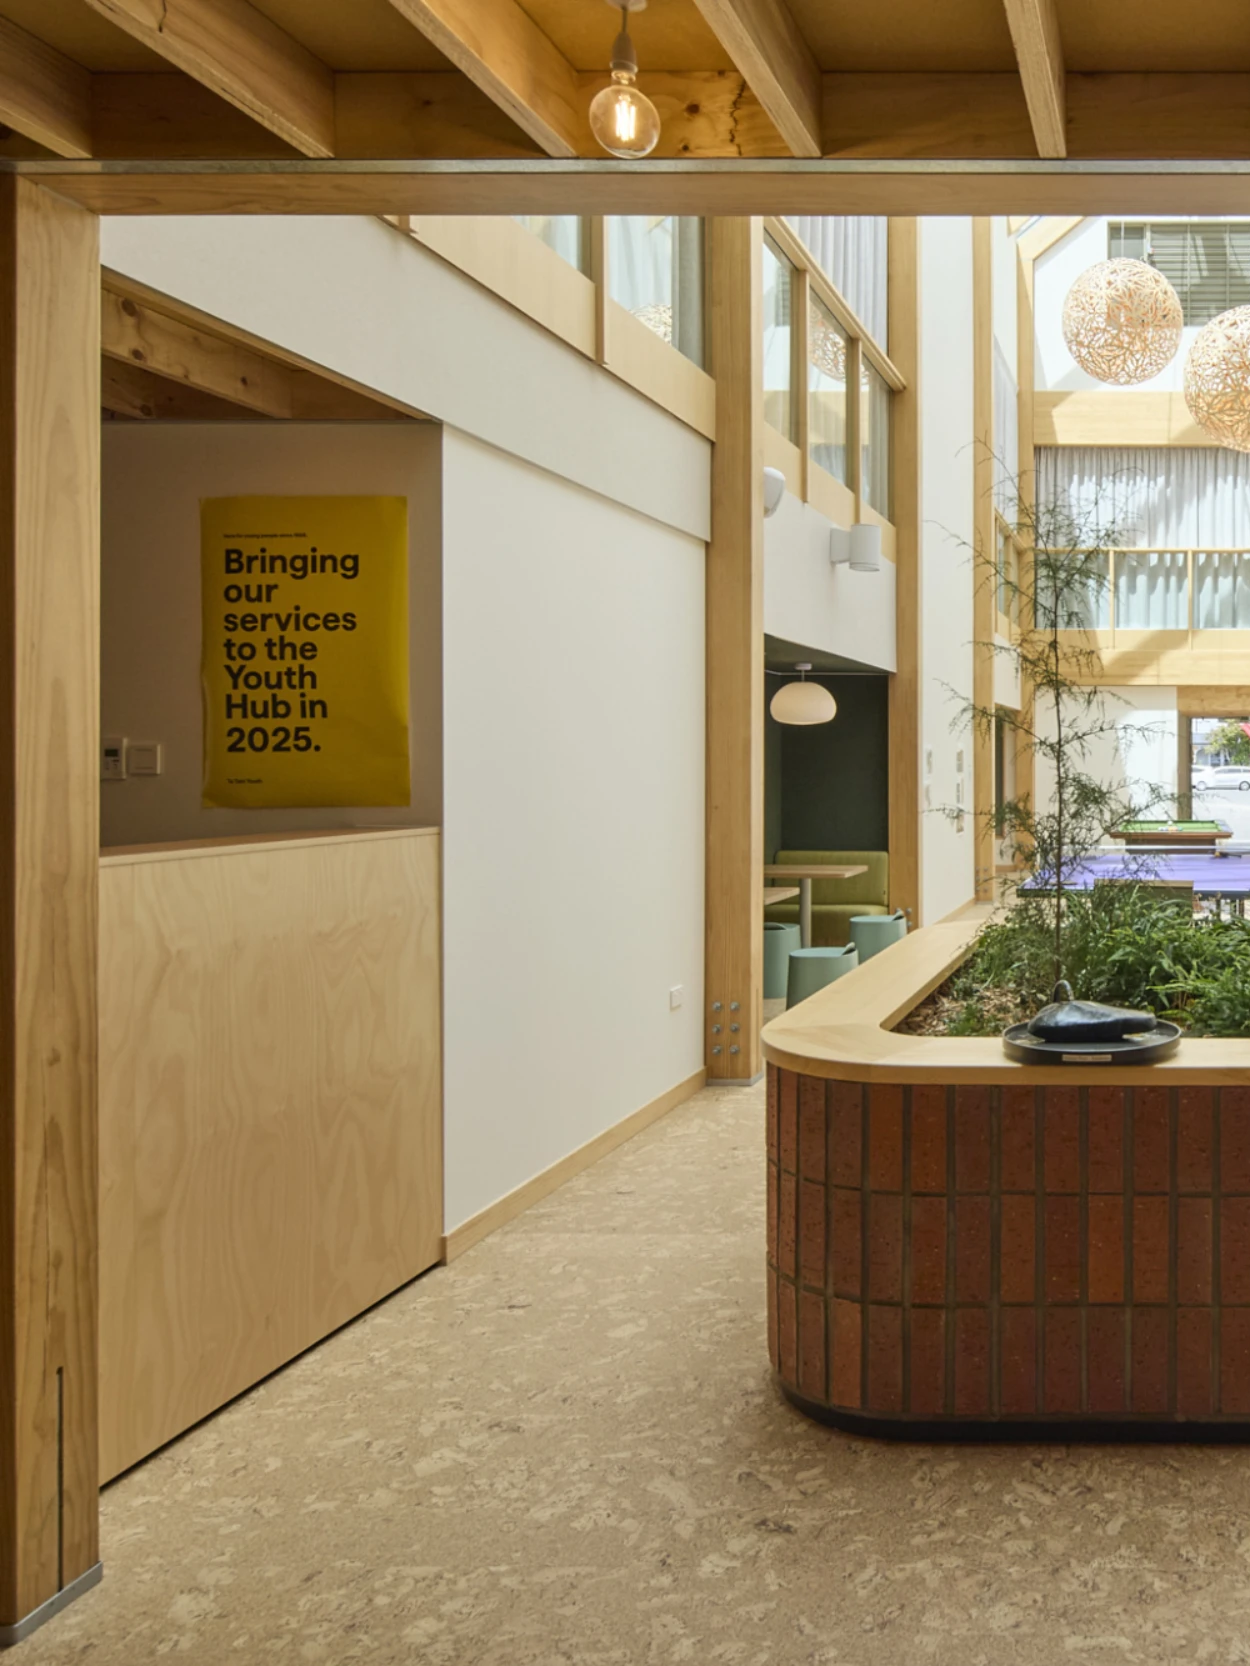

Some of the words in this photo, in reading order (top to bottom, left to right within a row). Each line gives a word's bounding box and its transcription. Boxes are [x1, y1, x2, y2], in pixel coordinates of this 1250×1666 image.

[224, 546, 360, 580] Bringing
[223, 583, 279, 603] our
[223, 604, 358, 632] services
[223, 638, 257, 661] to
[264, 635, 318, 661] the
[223, 664, 317, 690] Youth
[225, 692, 291, 719] Hub
[299, 692, 328, 719] in
[226, 726, 321, 753] 2025.
